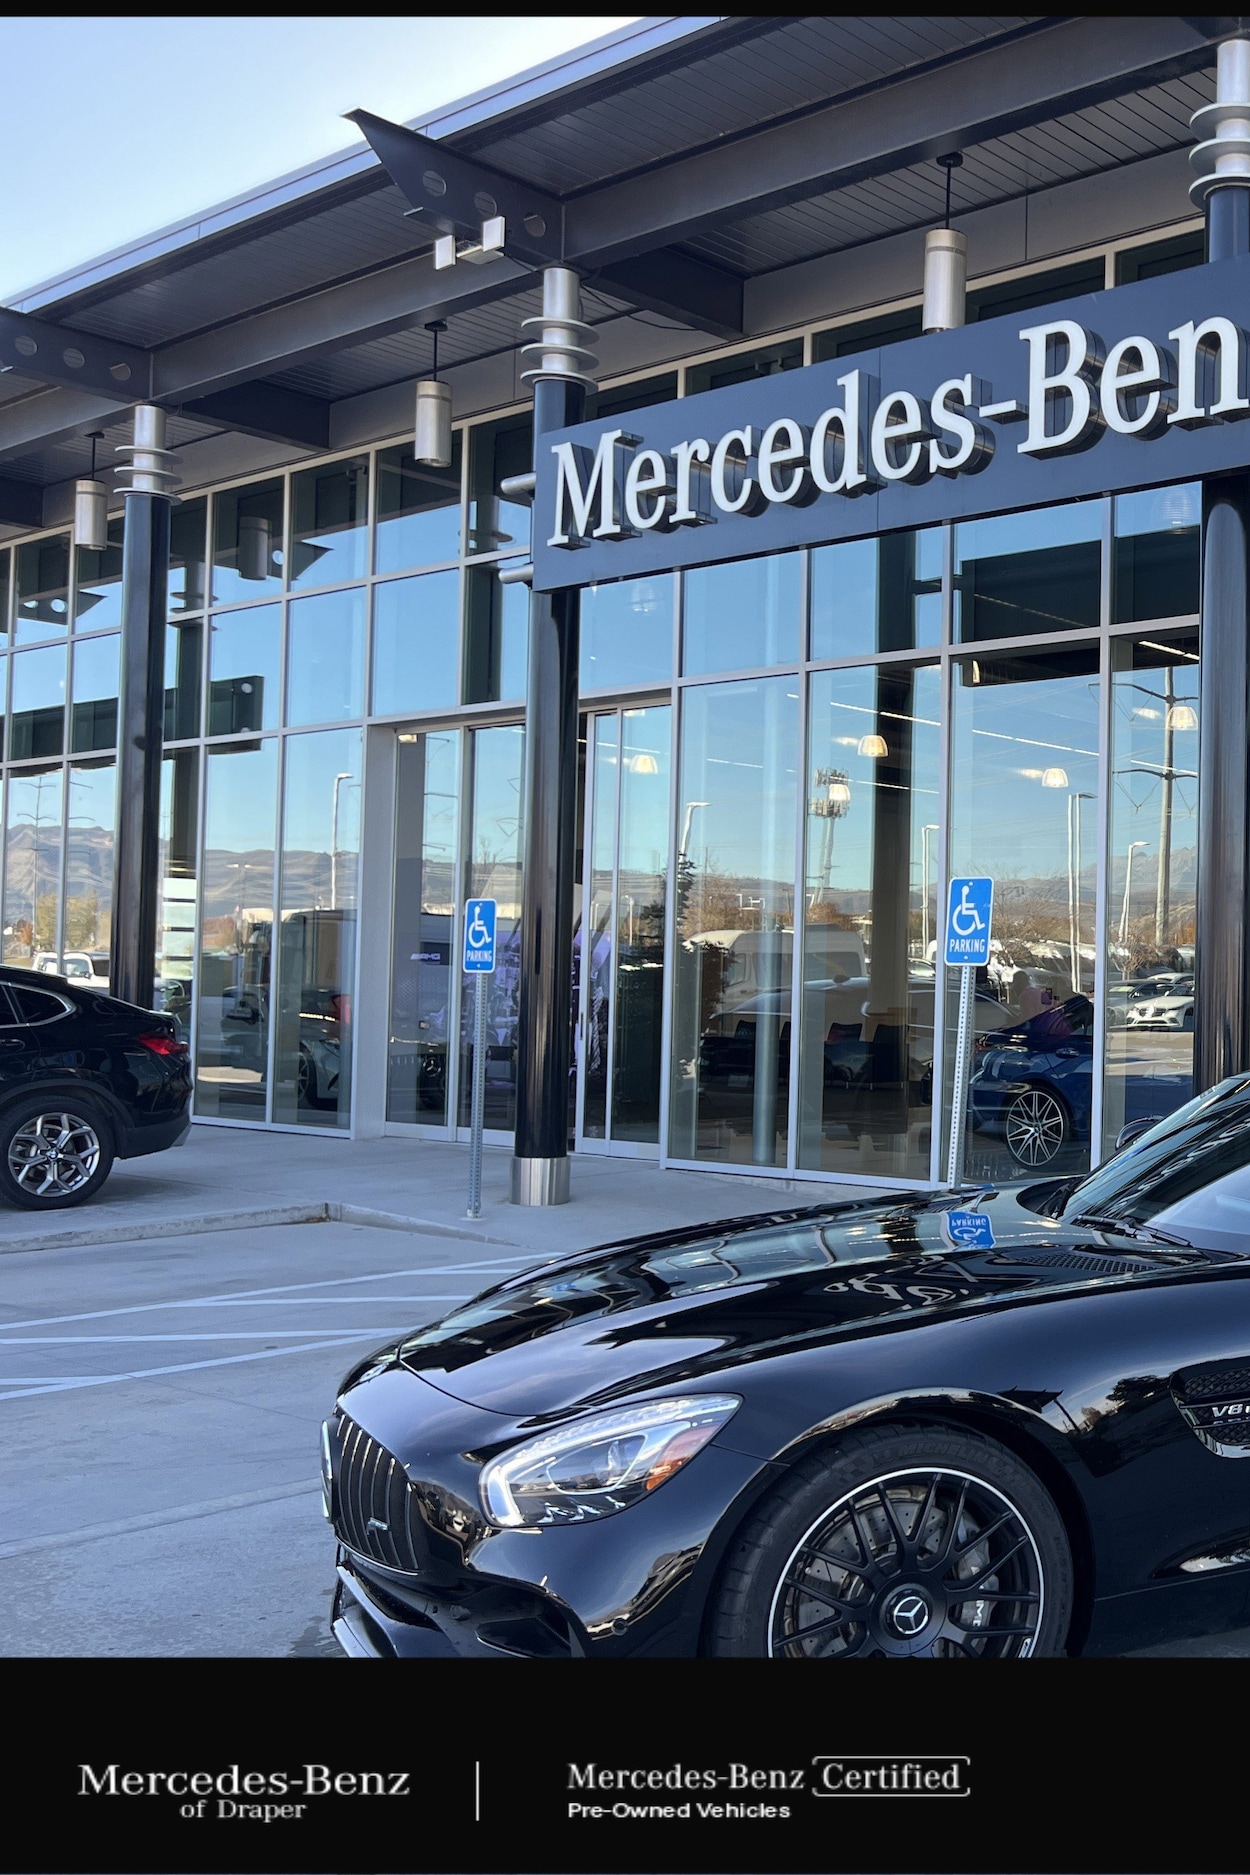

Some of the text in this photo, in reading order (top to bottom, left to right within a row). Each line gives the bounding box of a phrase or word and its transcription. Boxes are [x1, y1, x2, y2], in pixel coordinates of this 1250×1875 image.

[949, 938, 986, 953] PARKING
[466, 949, 493, 962] PARKING
[1212, 1404, 1243, 1418] V8
